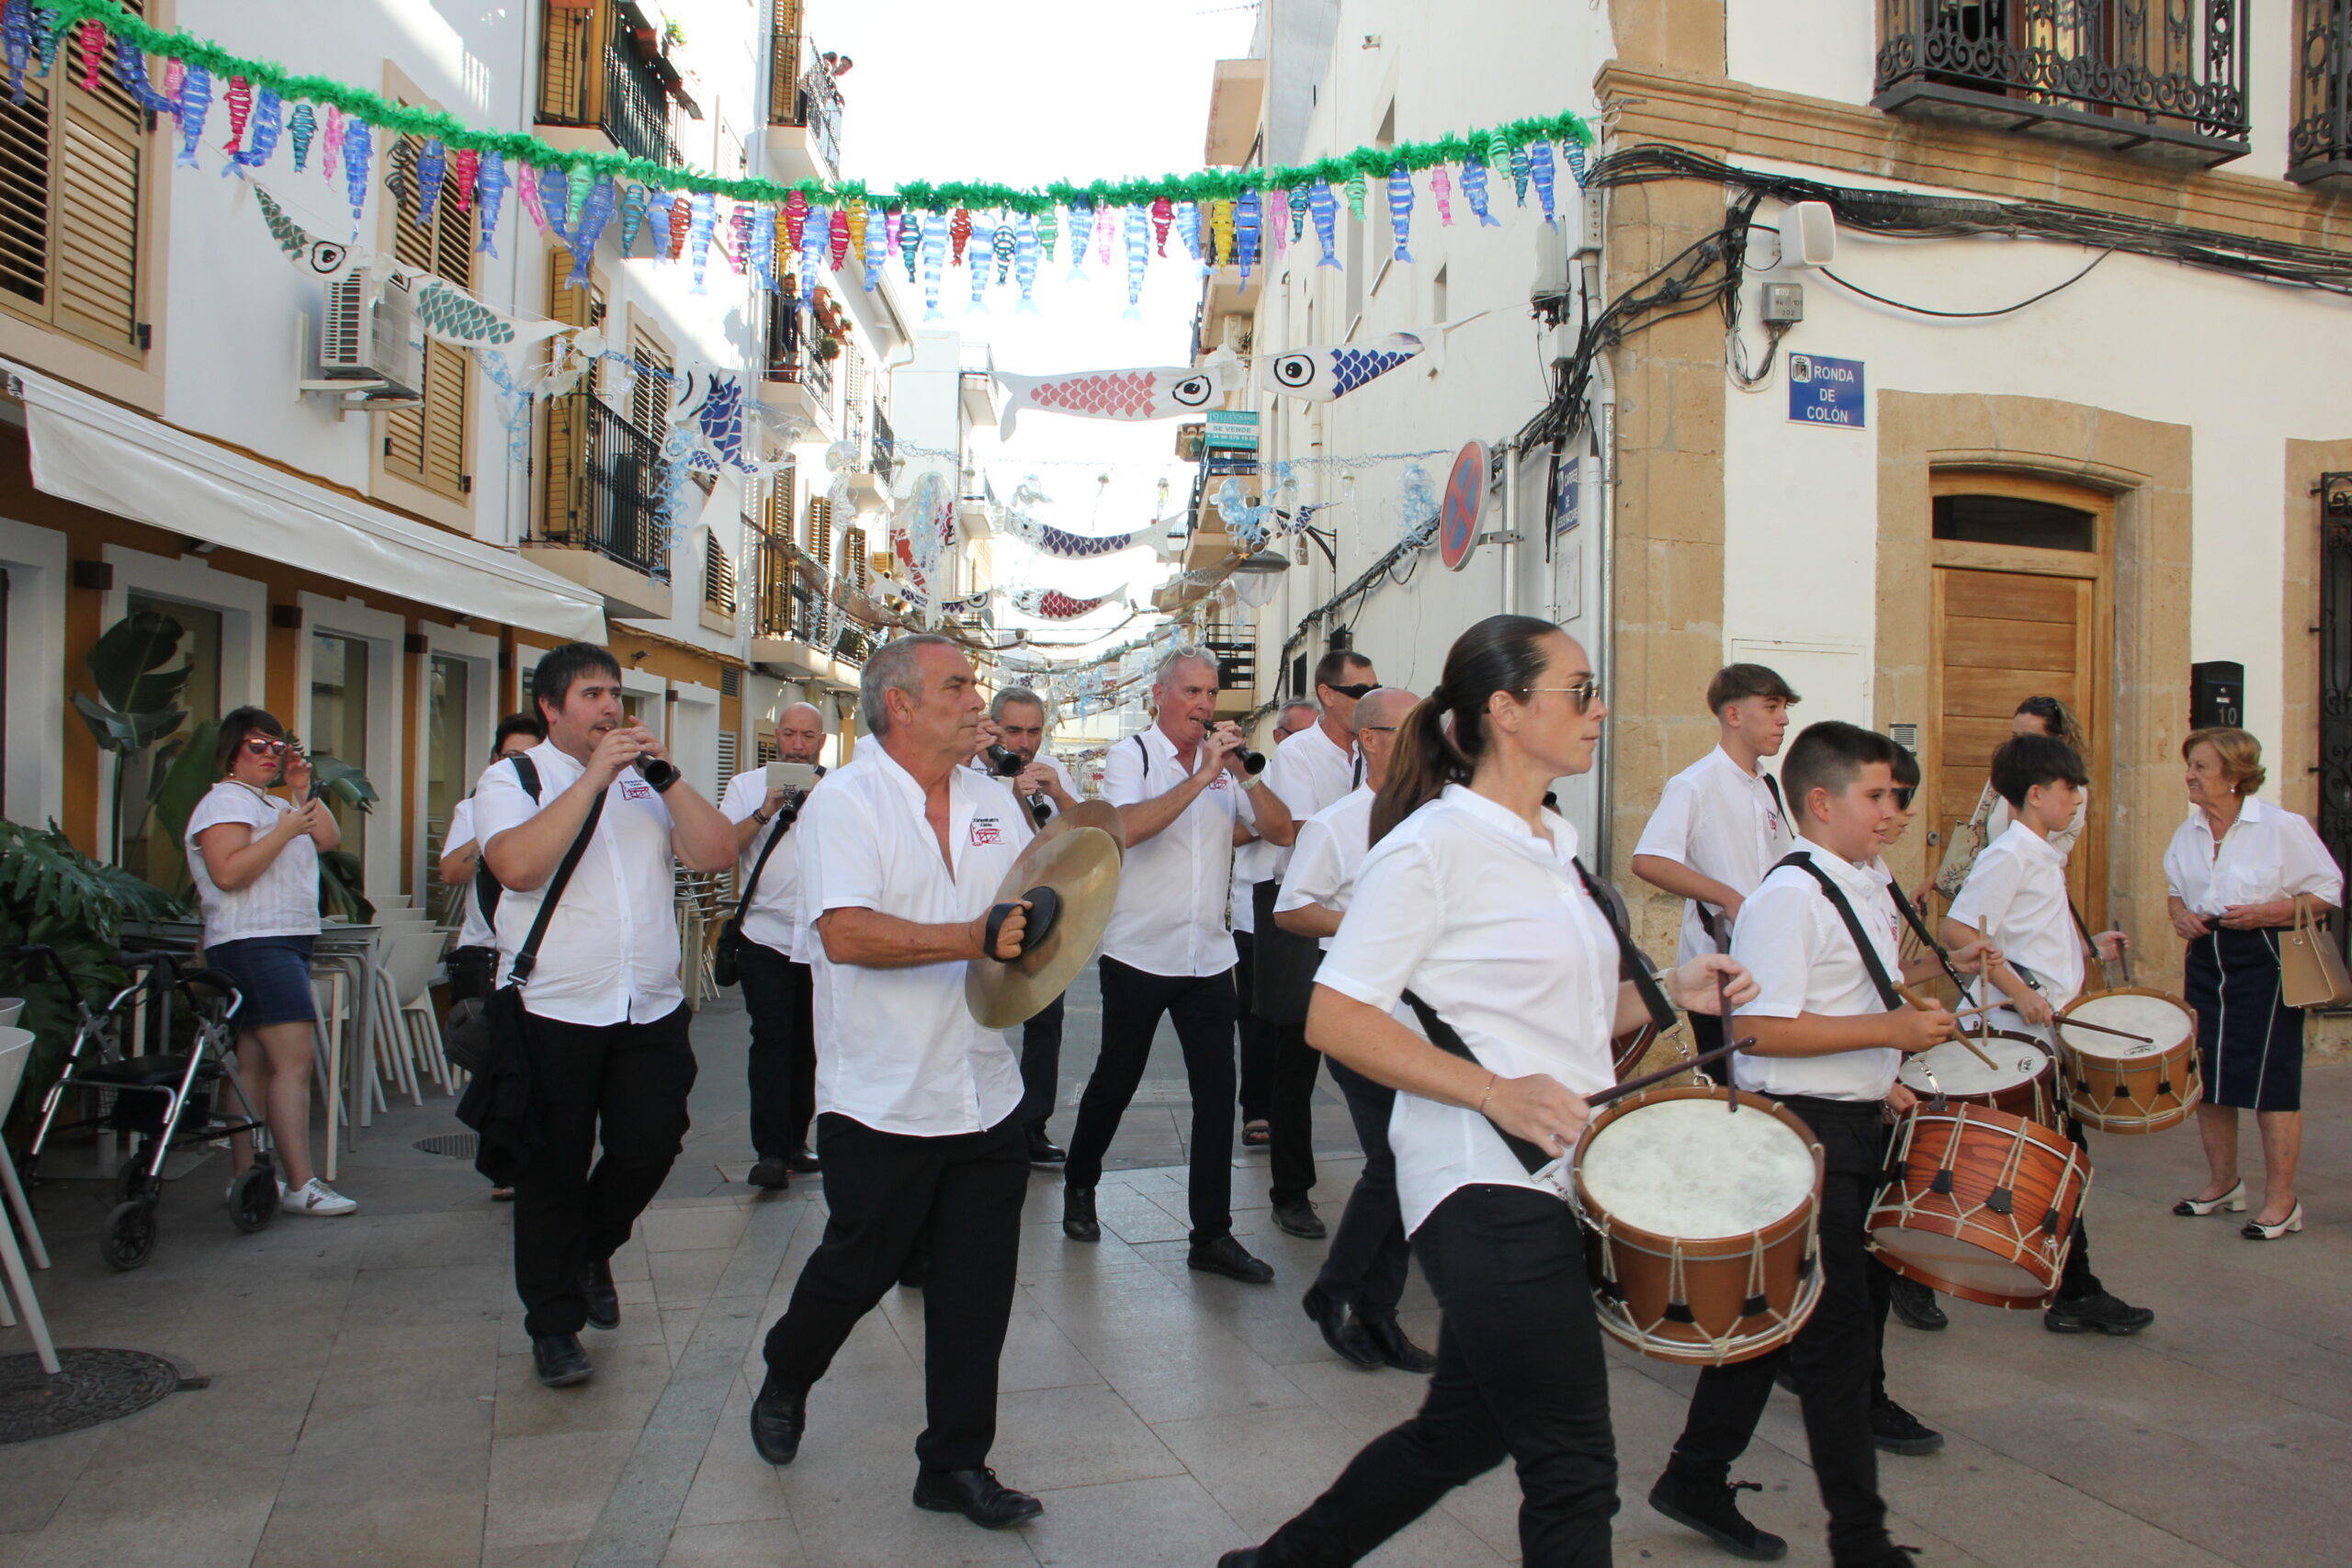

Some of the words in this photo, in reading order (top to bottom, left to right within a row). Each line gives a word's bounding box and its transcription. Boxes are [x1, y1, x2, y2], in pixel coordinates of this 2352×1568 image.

[1814, 366, 1854, 383] RONDA
[1819, 388, 1836, 402] DE
[1806, 405, 1849, 423] COLÓN
[1565, 468, 1577, 487] CARRER
[1566, 495, 1570, 507] DE
[2219, 705, 2238, 726] 10
